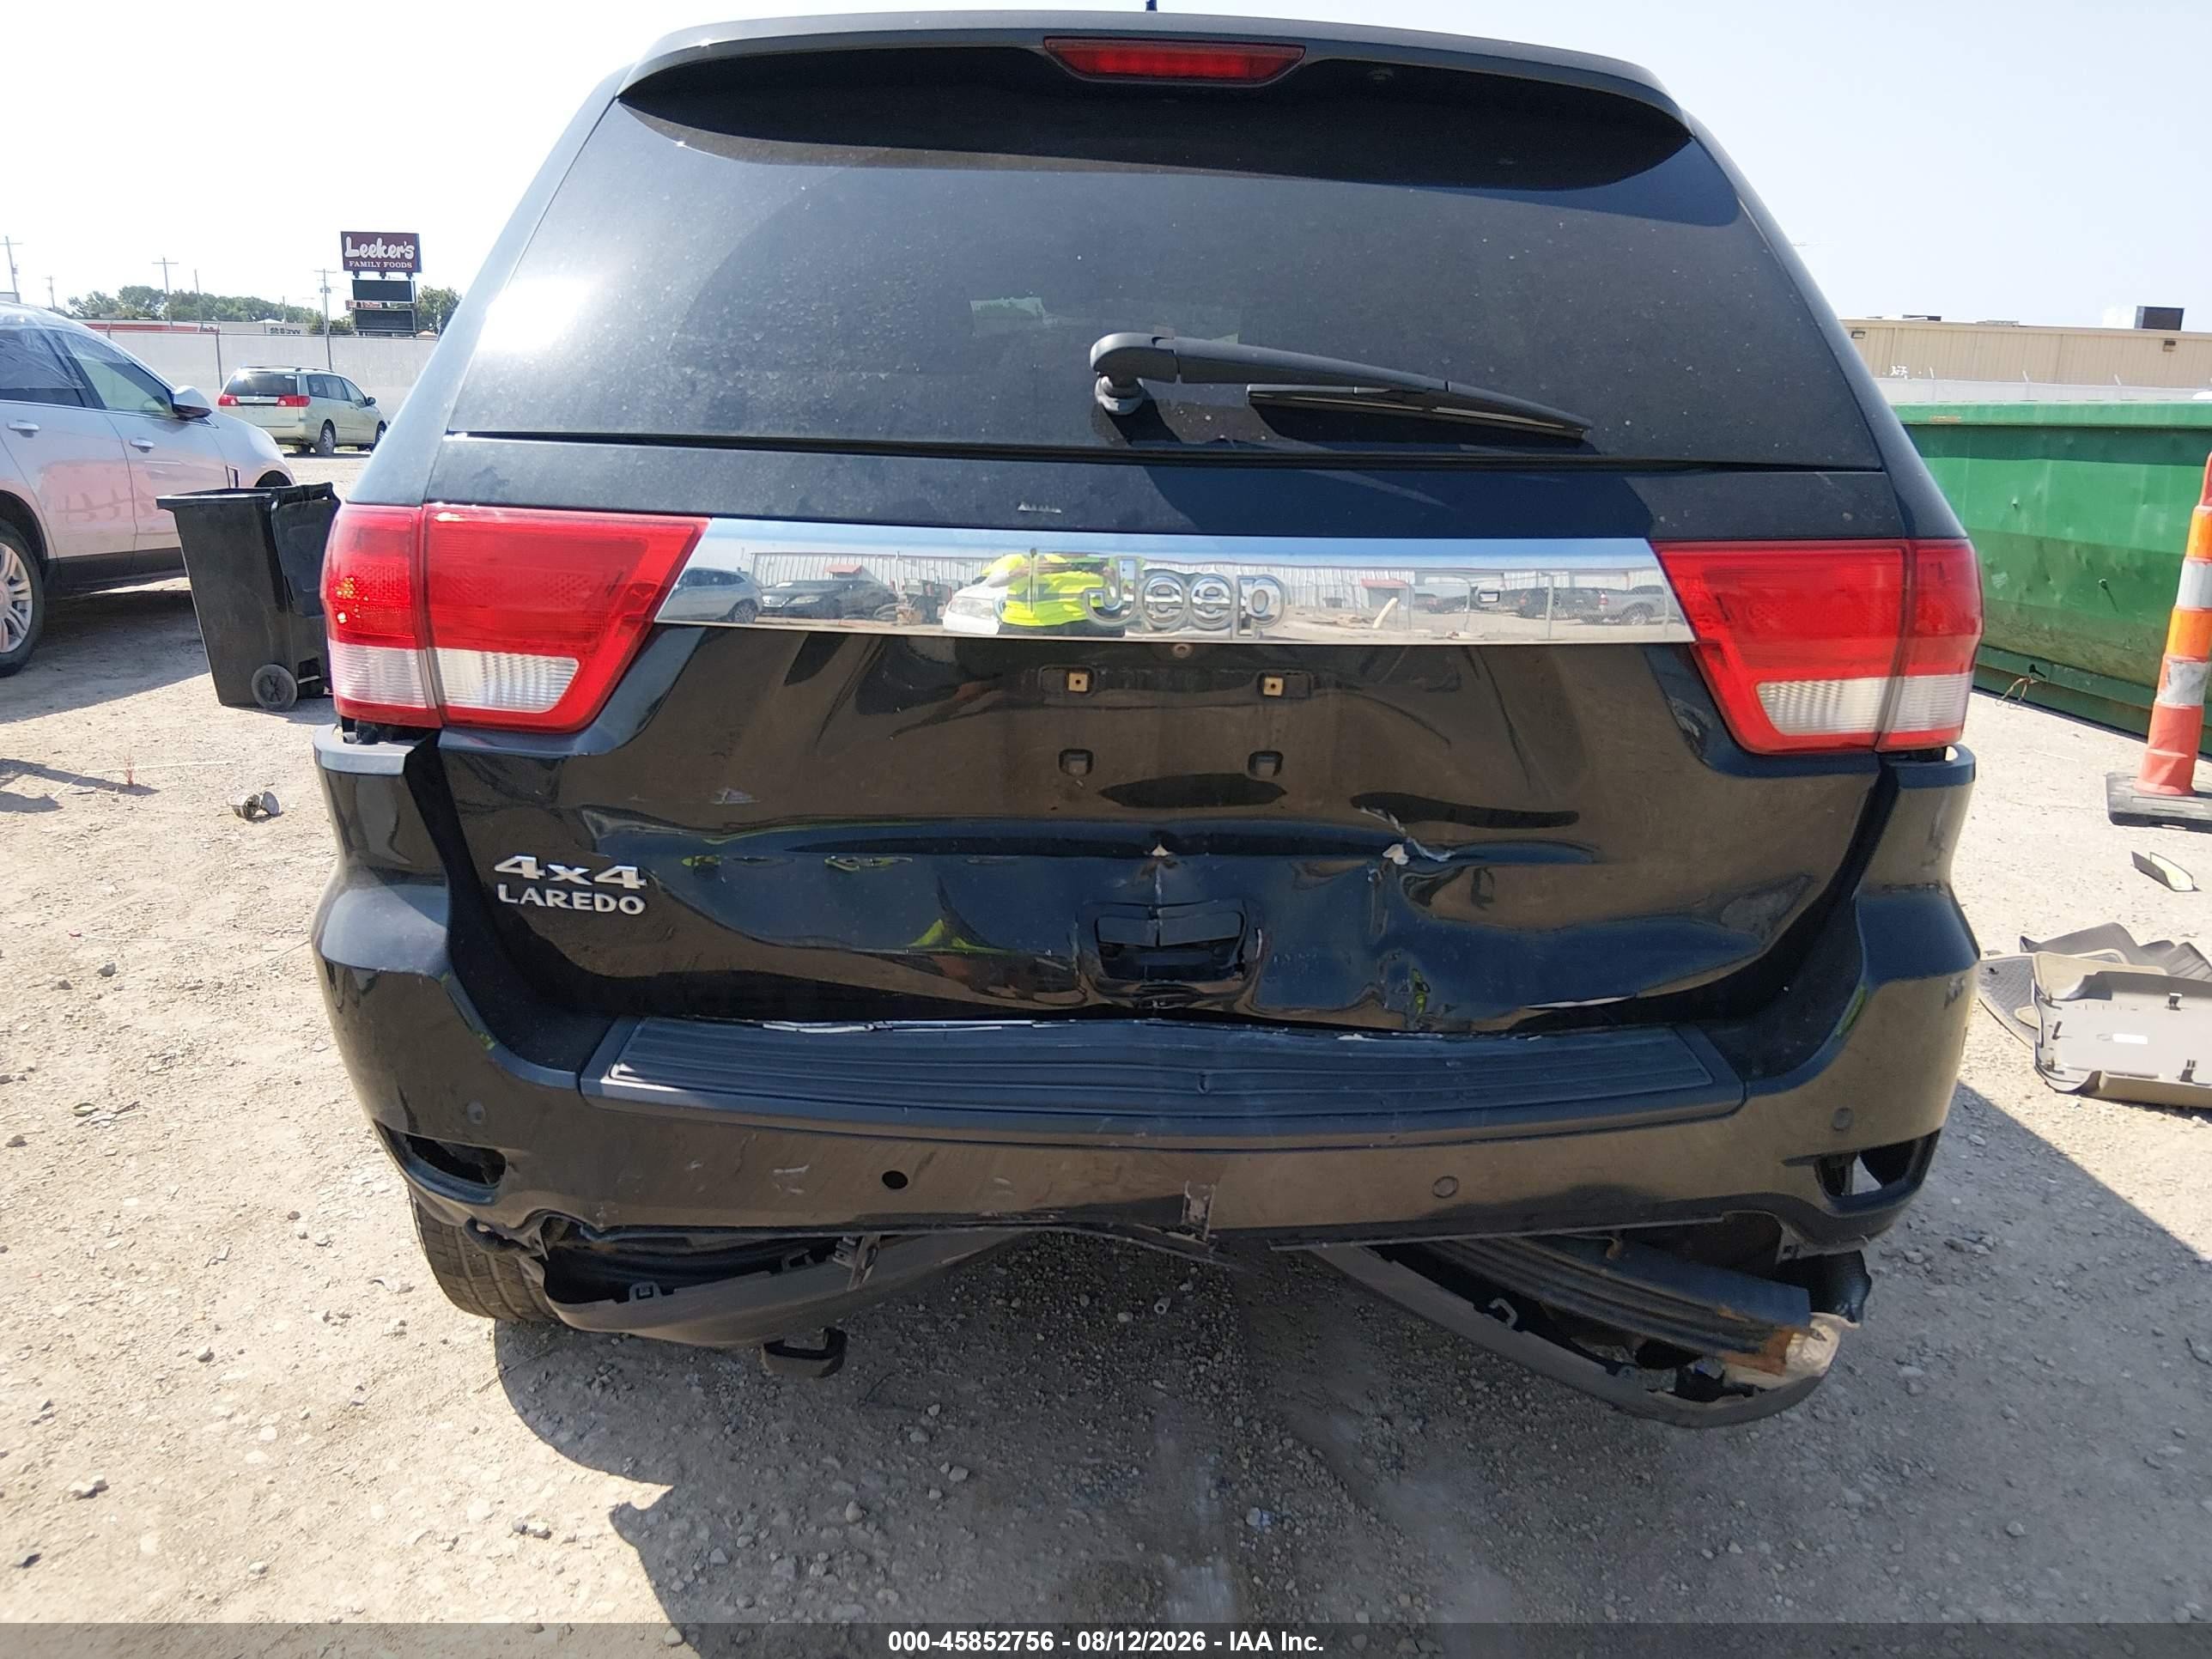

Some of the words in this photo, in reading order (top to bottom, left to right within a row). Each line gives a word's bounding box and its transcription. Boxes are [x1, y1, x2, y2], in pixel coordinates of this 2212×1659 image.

[345, 236, 415, 259] Leeker's
[1082, 556, 1285, 639] Jeep
[494, 855, 647, 890] 4x4
[497, 884, 646, 915] LAREDO
